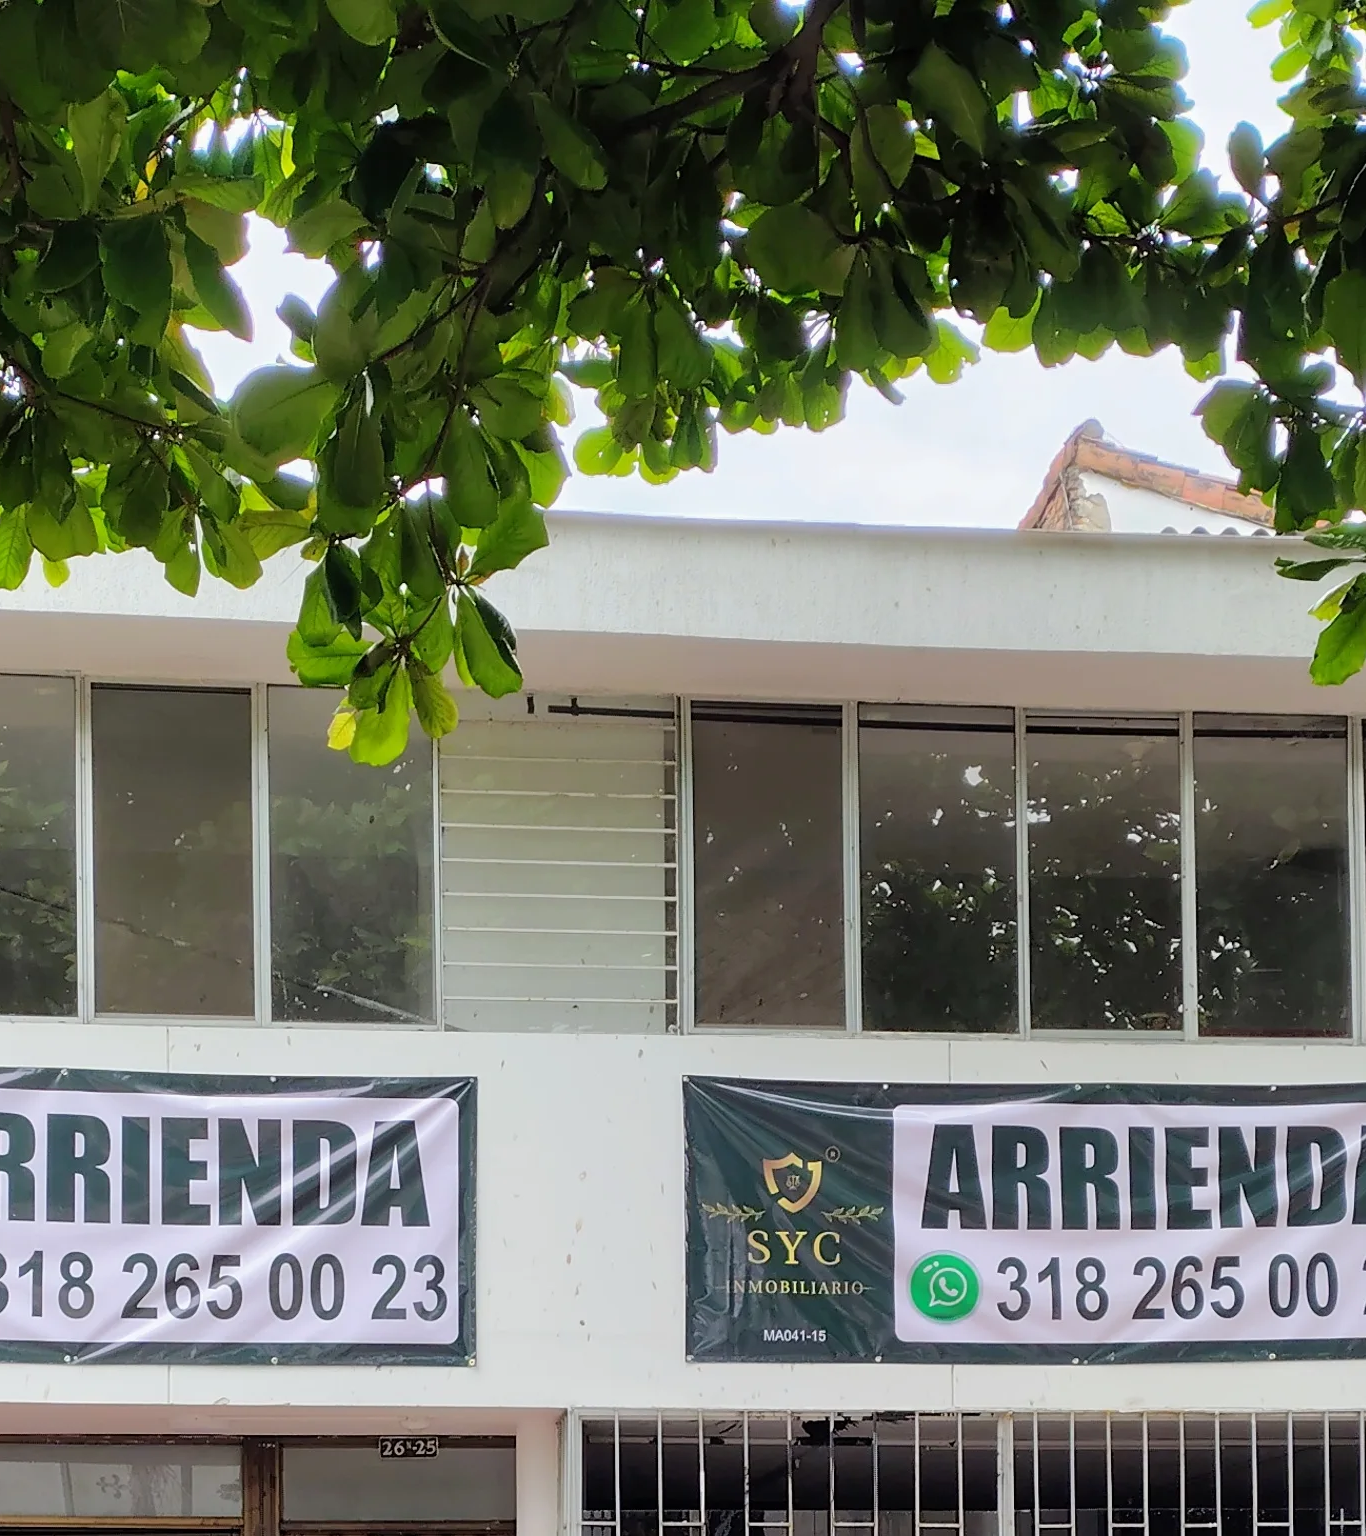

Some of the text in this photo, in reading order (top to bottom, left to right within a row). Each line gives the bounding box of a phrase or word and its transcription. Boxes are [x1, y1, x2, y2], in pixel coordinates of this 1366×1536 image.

[747, 1229, 841, 1266] SYC
[121, 1252, 243, 1320] 265
[268, 1252, 345, 1321] 00
[371, 1254, 448, 1321] 23
[726, 1279, 864, 1296] INMOBILIARIO
[996, 1256, 1110, 1321] 318
[1131, 1255, 1245, 1320] 265
[1268, 1252, 1338, 1318] 00
[763, 1329, 827, 1343] MA041-15
